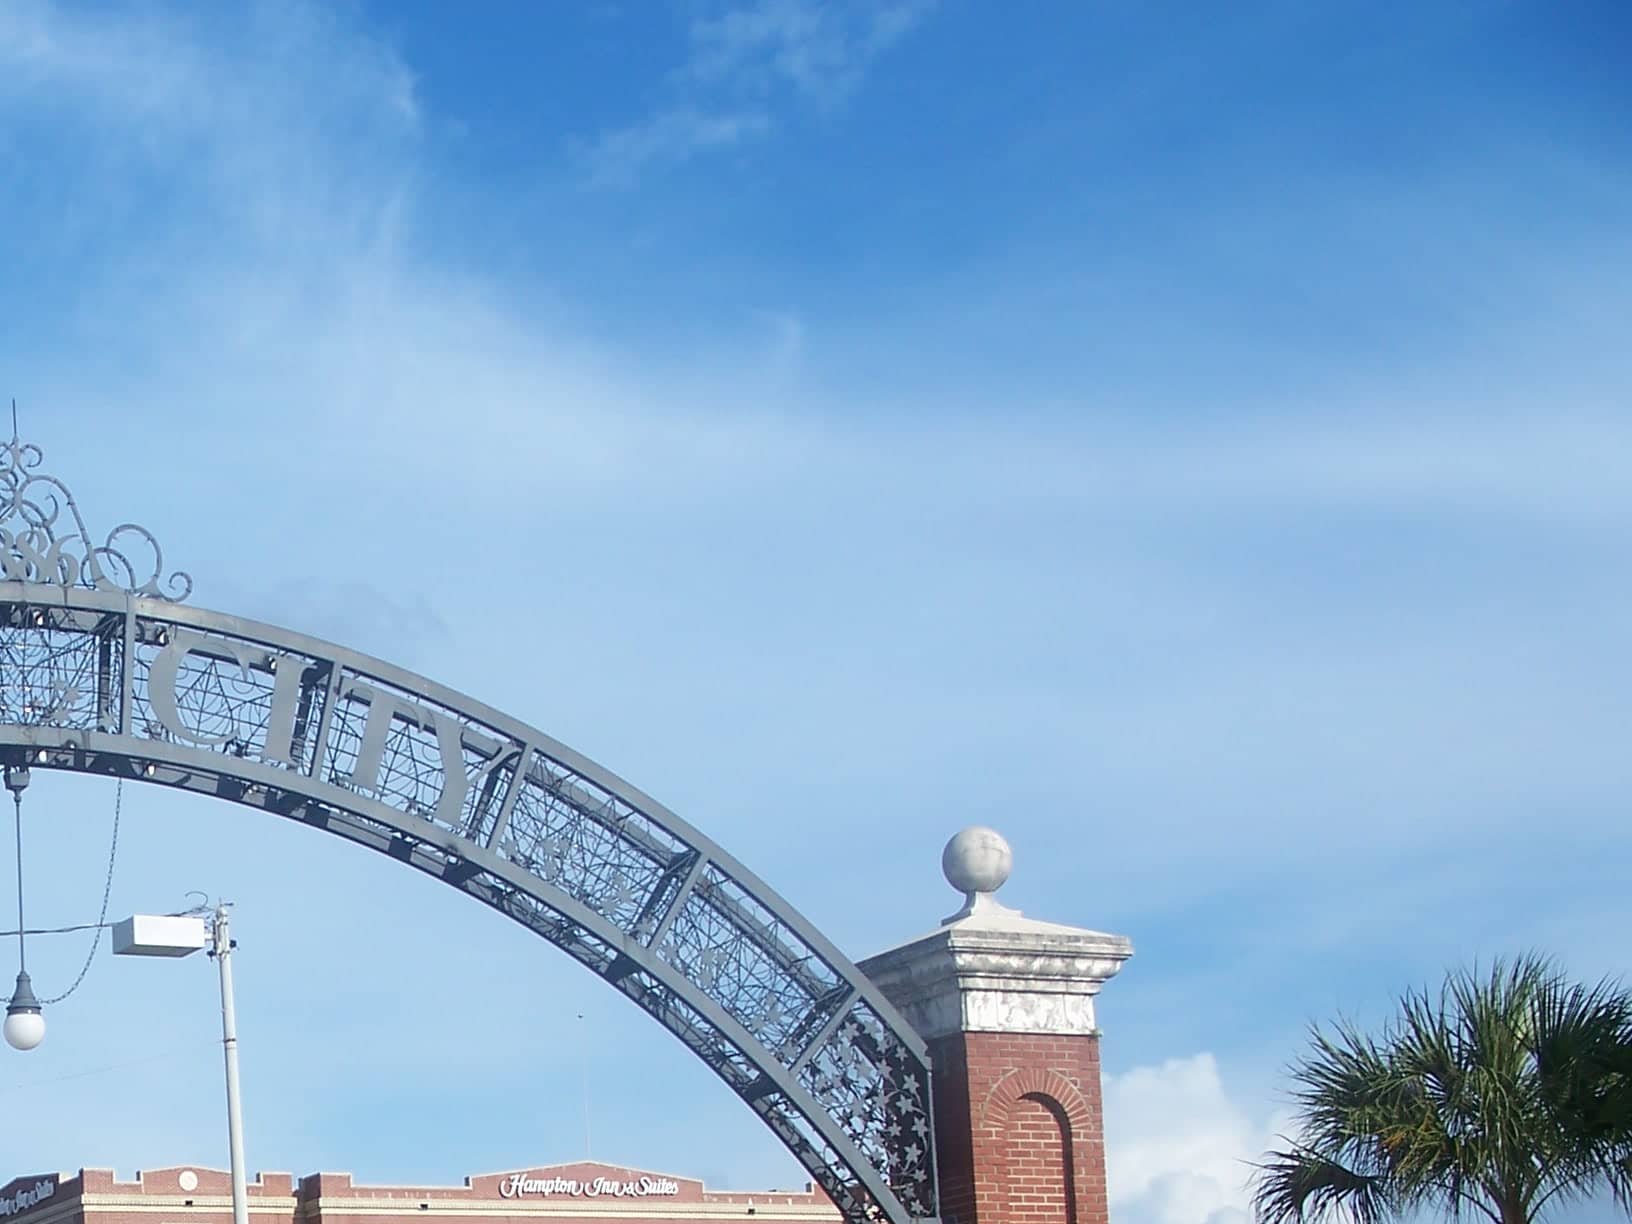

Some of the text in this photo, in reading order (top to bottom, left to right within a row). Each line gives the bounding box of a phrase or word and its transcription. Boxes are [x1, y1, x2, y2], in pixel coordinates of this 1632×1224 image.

[148, 630, 520, 828] CITY
[500, 1174, 584, 1198] Hampton
[584, 1176, 625, 1197] Inn
[635, 1176, 679, 1195] Suites
